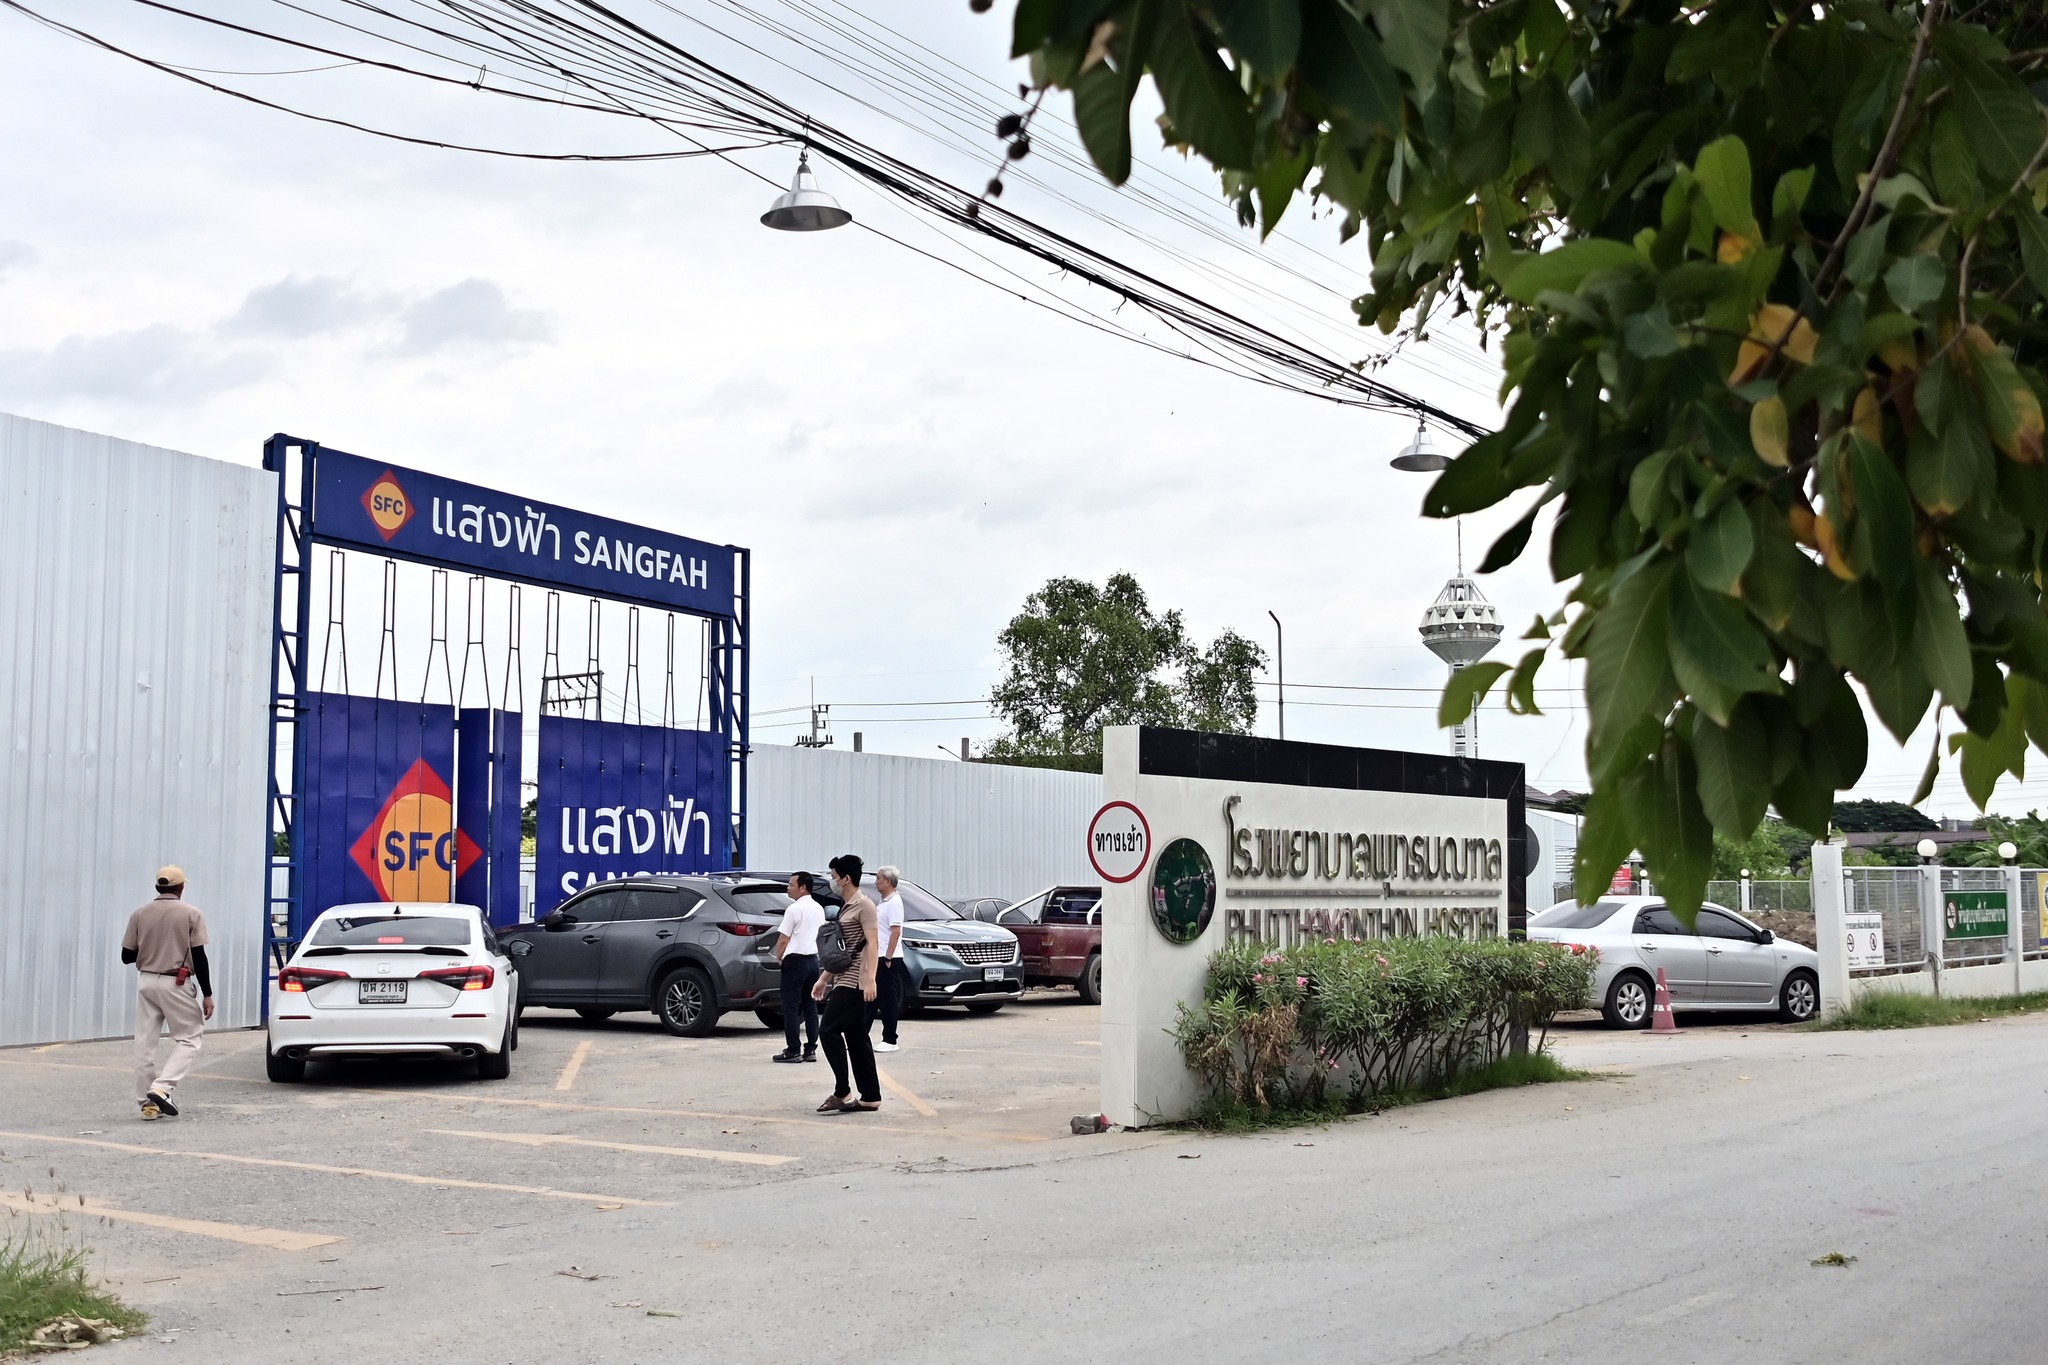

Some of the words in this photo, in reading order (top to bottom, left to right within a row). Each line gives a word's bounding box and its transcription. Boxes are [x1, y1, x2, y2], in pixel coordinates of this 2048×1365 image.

[373, 494, 404, 516] SFC
[432, 496, 561, 560] แสงฟ้า
[574, 530, 708, 590] SANGFAH
[561, 794, 711, 856] แสงฟ้า
[1095, 824, 1143, 852] ทางเข้า
[384, 830, 455, 872] SFC
[380, 982, 405, 993] 2119
